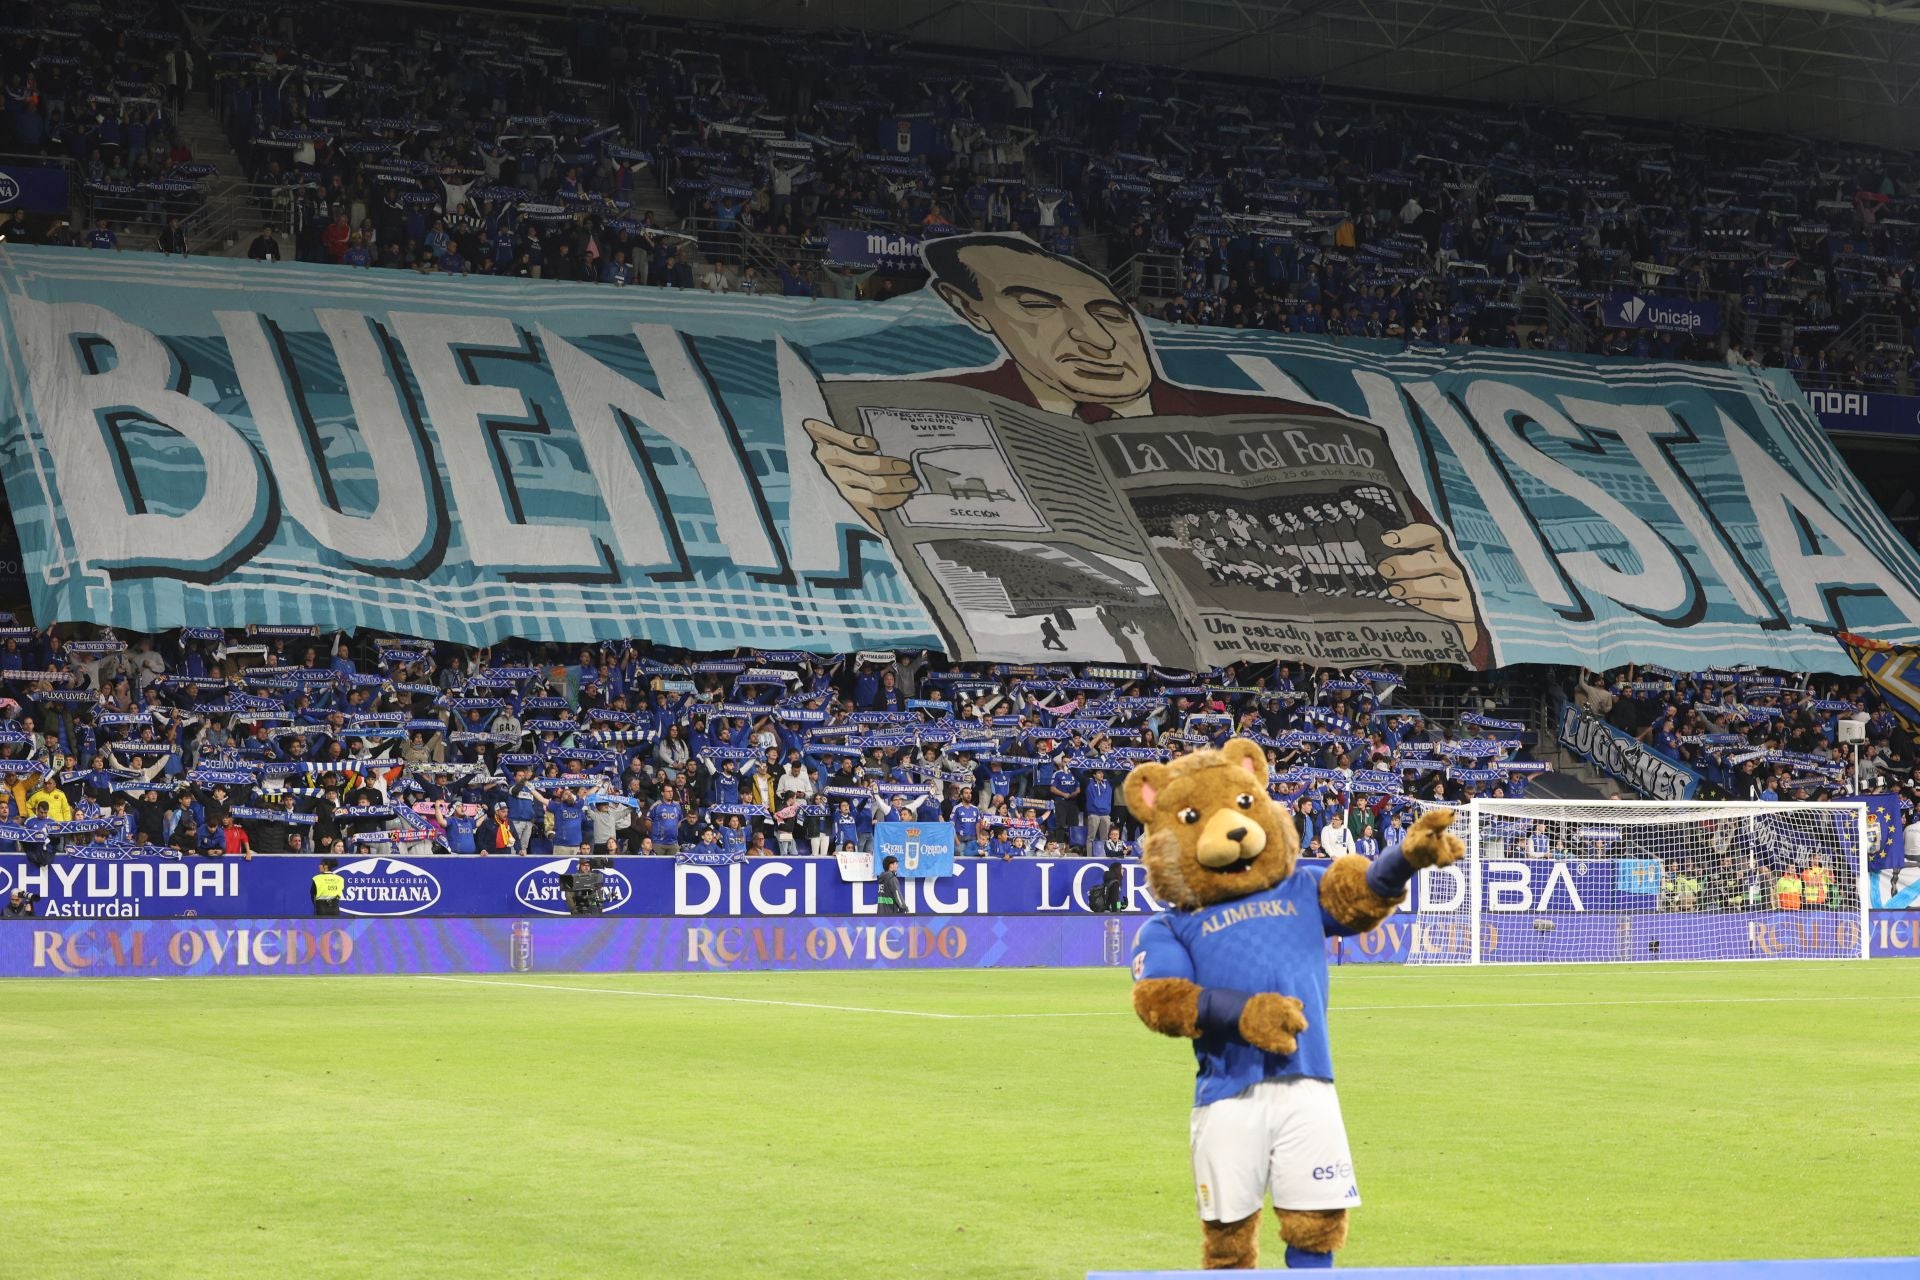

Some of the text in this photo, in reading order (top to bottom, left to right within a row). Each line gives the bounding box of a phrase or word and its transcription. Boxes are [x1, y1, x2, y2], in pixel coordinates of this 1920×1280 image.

[1648, 306, 1702, 328] Unicaja
[910, 424, 954, 432] OVIEDO
[1112, 430, 1376, 476] La Voz del Fondo
[198, 631, 218, 639] CICLO
[1204, 618, 1237, 634] Un
[1242, 622, 1311, 643] estadio
[1315, 628, 1359, 647] para
[1214, 638, 1242, 652] un
[249, 678, 298, 688] Real OVIEDO
[354, 711, 402, 721] Real OVIEDO
[571, 751, 593, 759] CICLO
[723, 750, 745, 758] CICLO
[75, 823, 99, 832] CICLO
[1008, 829, 1031, 837] CICLO
[91, 850, 116, 859] CICLO
[18, 863, 238, 897] HYUNDAI
[347, 877, 428, 885] CENTRAL LECHERA
[674, 862, 816, 915] DIGI
[46, 898, 140, 918] Asturdai
[1201, 899, 1299, 937] ALIMERKA
